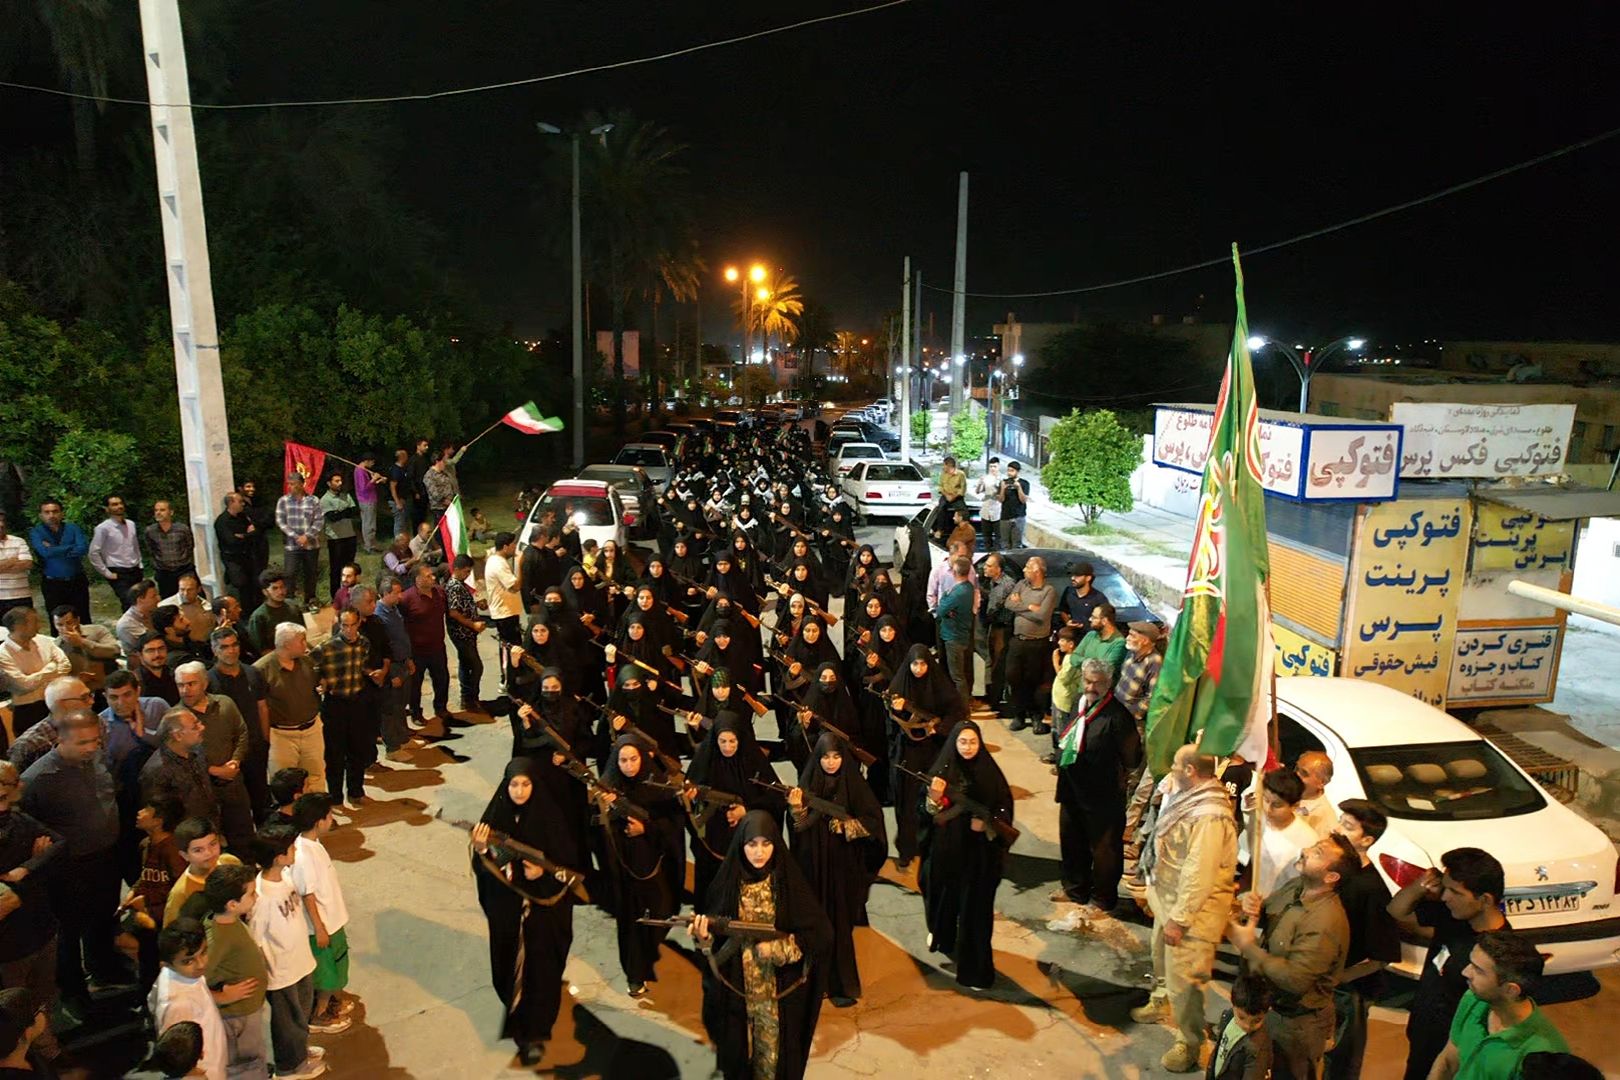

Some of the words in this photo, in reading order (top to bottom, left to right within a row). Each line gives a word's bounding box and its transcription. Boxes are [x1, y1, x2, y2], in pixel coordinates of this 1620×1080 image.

[1310, 433, 1394, 489] فتوکپی
[1439, 437, 1488, 472] فکس
[1494, 437, 1562, 474] فتوکپی
[1373, 507, 1460, 549] فتوکپی
[1475, 531, 1536, 552] پرینت
[1515, 551, 1567, 571] پرس
[1365, 563, 1450, 597] پرینت
[1360, 614, 1443, 642] پرس
[1457, 633, 1508, 656] کردن
[1508, 631, 1553, 654] فنری
[1282, 644, 1329, 677] فتوکپی
[1354, 653, 1404, 677] حقوقی
[1404, 651, 1438, 675] فیش
[1459, 661, 1498, 677] جزوه
[1498, 662, 1505, 675] و
[1508, 656, 1544, 674] کتاب
